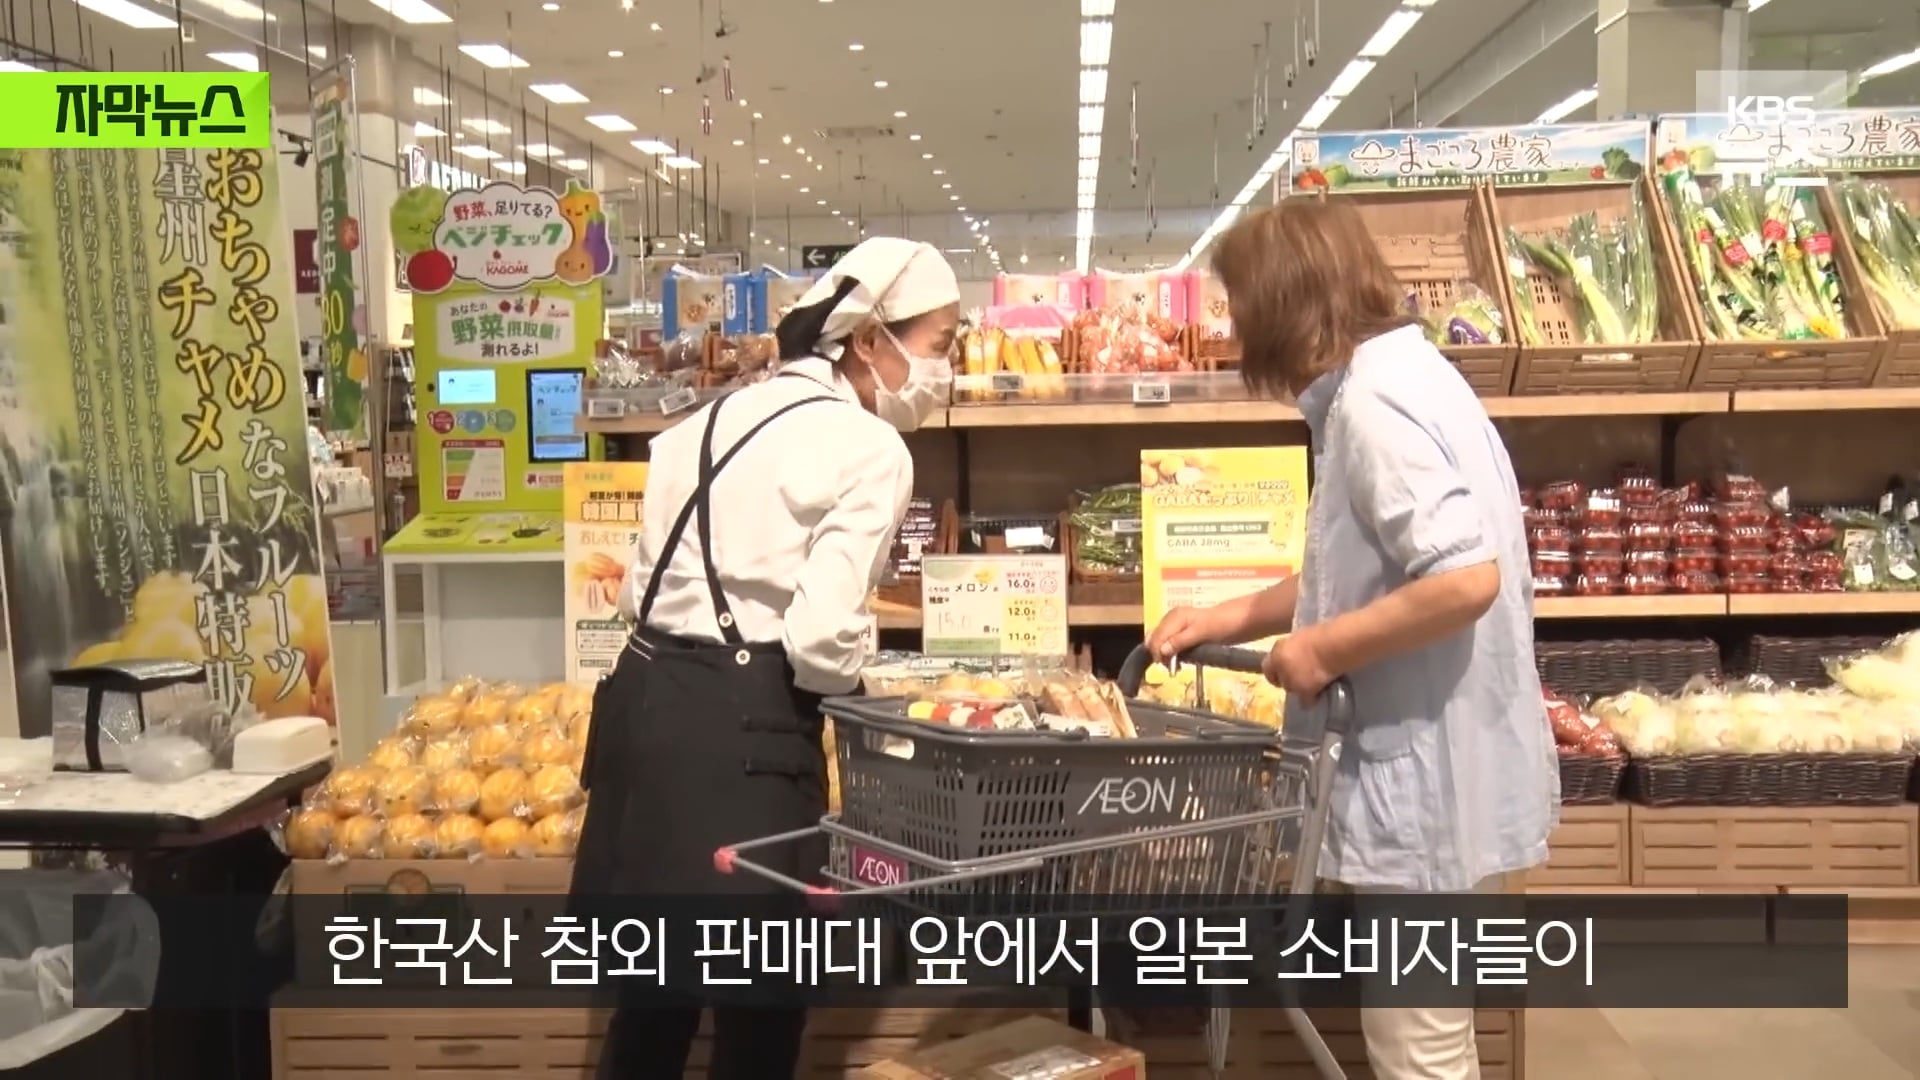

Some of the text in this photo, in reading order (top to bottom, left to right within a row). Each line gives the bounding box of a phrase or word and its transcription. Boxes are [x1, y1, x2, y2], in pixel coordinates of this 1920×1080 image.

[1399, 133, 1551, 172] まごころ農家
[442, 223, 564, 249] ベジチェック
[486, 263, 529, 275] KAGOME
[206, 148, 306, 701] おちゃめなフルーツ
[954, 583, 989, 593] メロン
